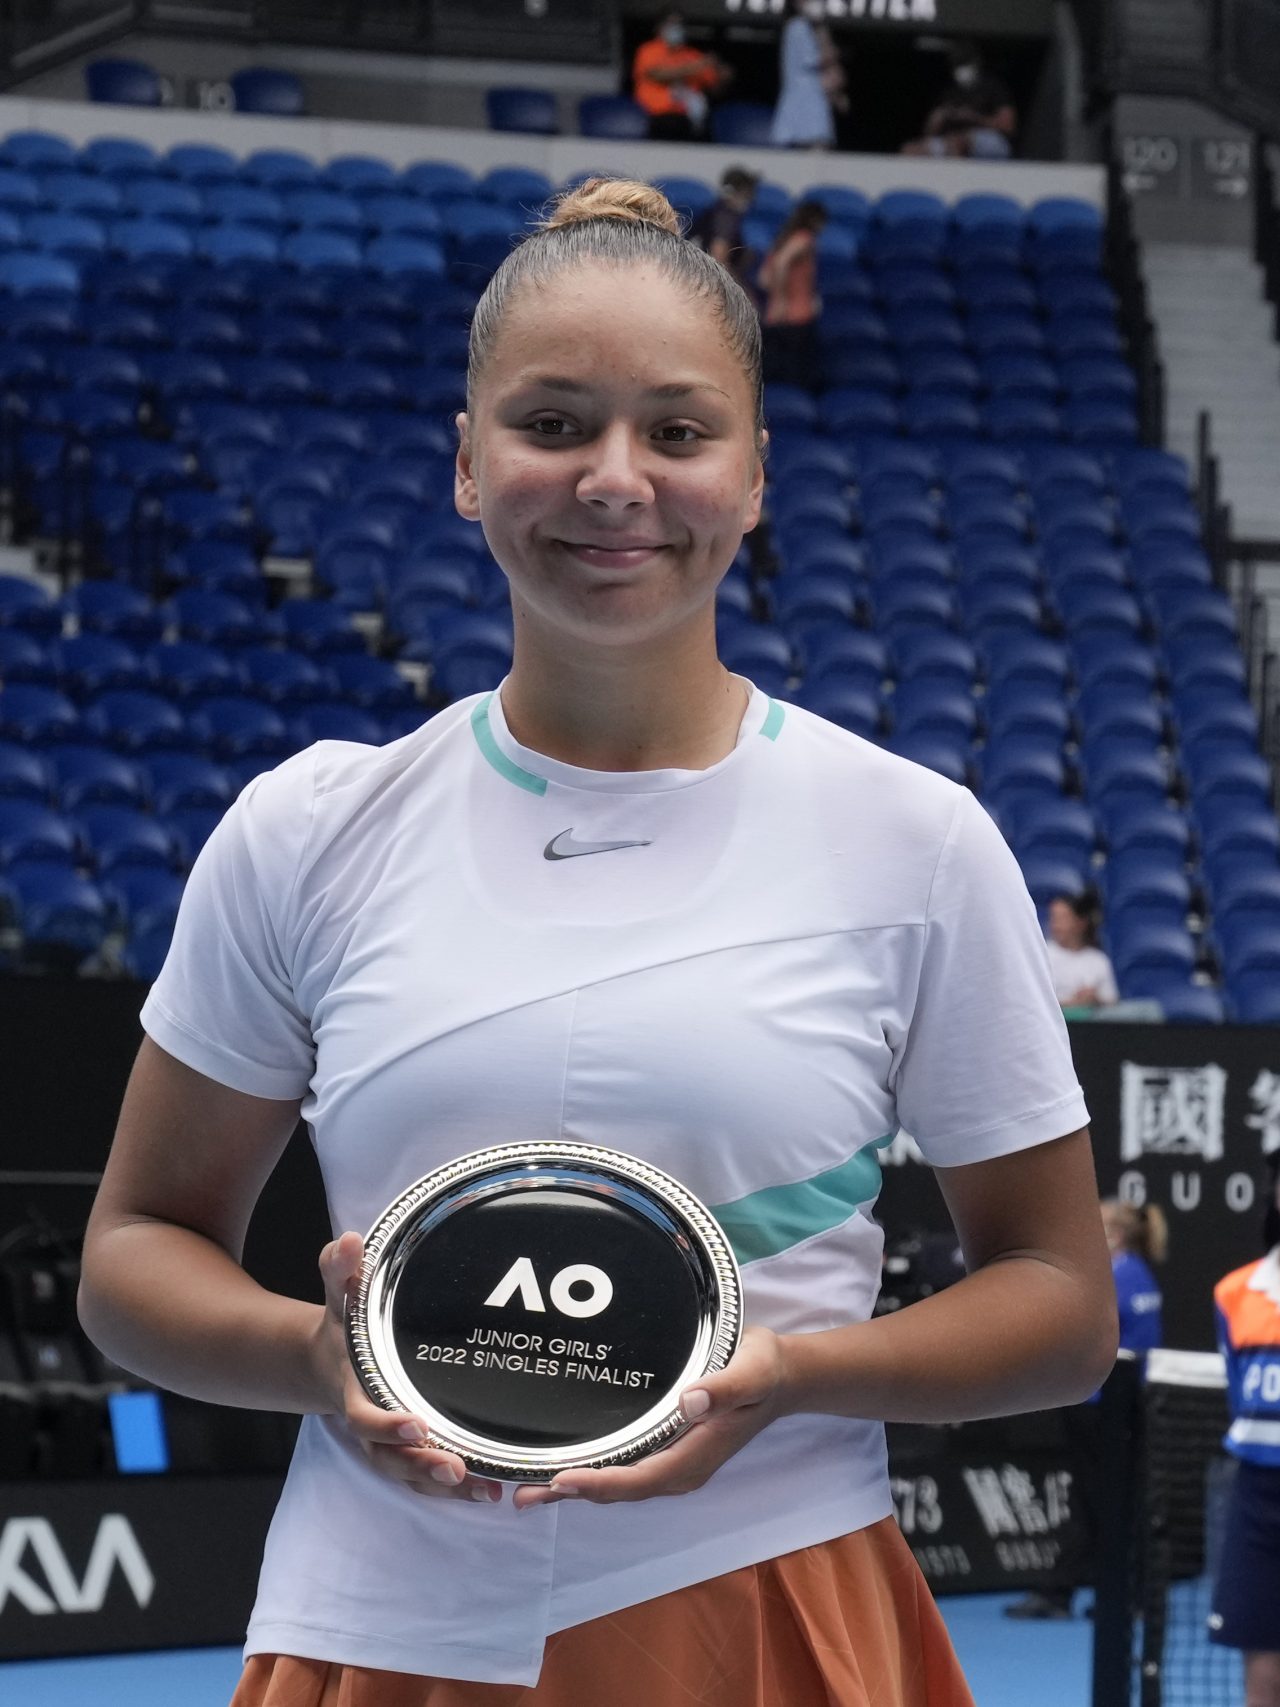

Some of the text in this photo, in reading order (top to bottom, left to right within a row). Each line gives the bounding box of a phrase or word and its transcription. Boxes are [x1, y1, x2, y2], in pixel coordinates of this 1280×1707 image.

[483, 1256, 614, 1319] AO
[466, 1328, 543, 1353] JUNIOR
[416, 1344, 655, 1390] 2022 SINGLES FINALIST
